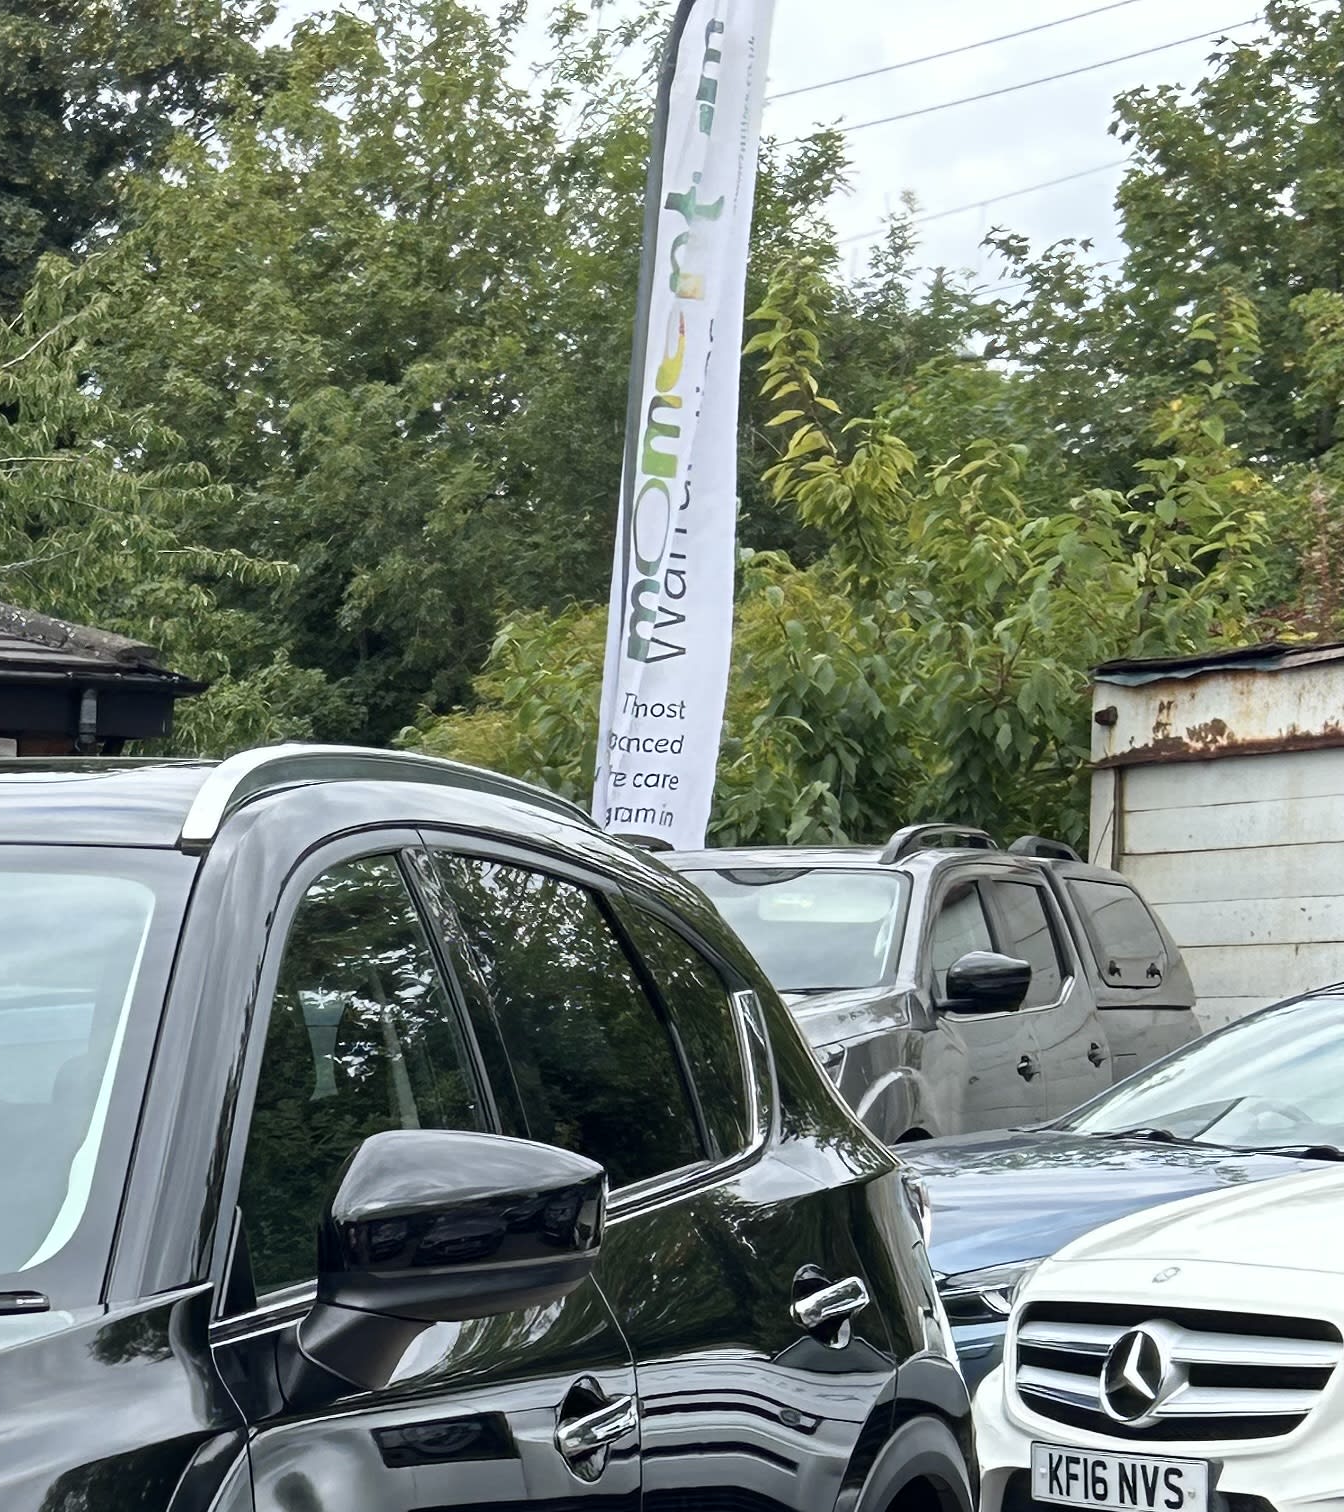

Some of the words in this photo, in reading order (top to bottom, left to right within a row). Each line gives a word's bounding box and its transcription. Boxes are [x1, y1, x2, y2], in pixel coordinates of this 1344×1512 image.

[632, 772, 679, 790] care
[659, 803, 674, 827] in
[1048, 1453, 1108, 1501] KF16
[1118, 1462, 1184, 1510] NVS
